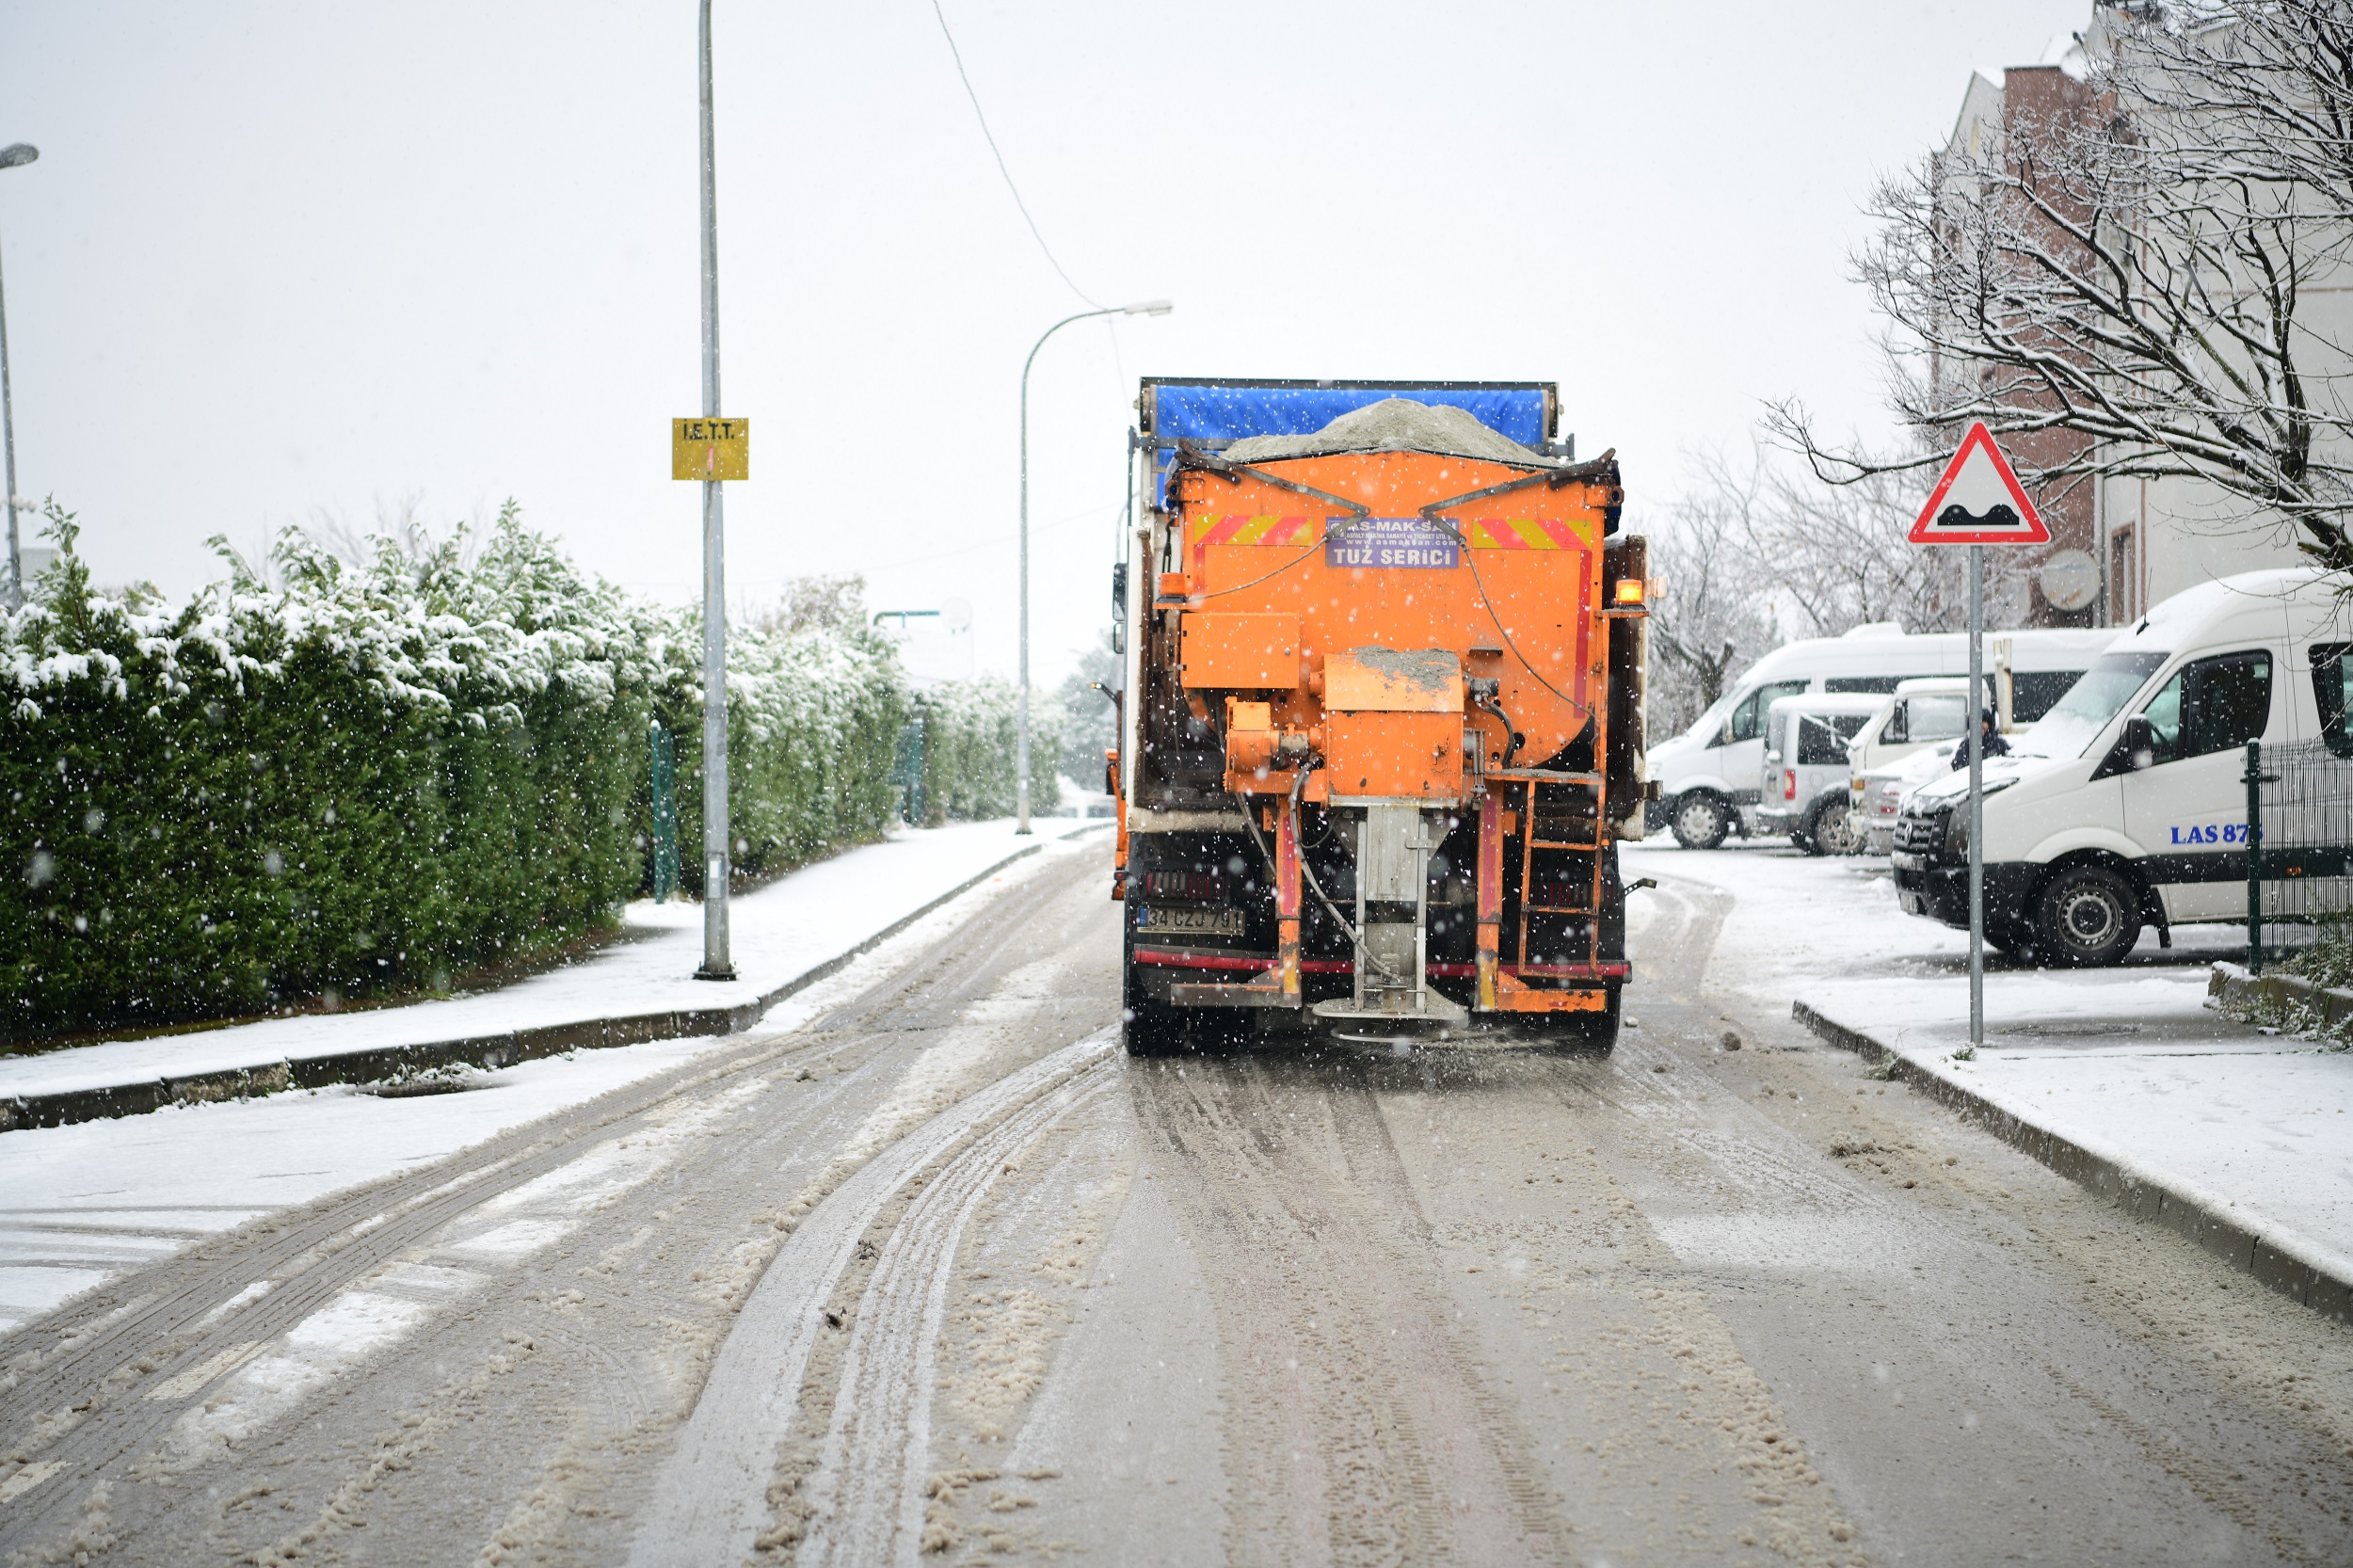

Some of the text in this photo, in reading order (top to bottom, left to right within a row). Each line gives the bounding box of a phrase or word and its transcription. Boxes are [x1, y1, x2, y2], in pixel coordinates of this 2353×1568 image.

[1334, 549, 1451, 566] TUZ SERİCİ
[2170, 823, 2264, 845] LAS 87
[1149, 909, 1240, 928] 34 CZJ 791
